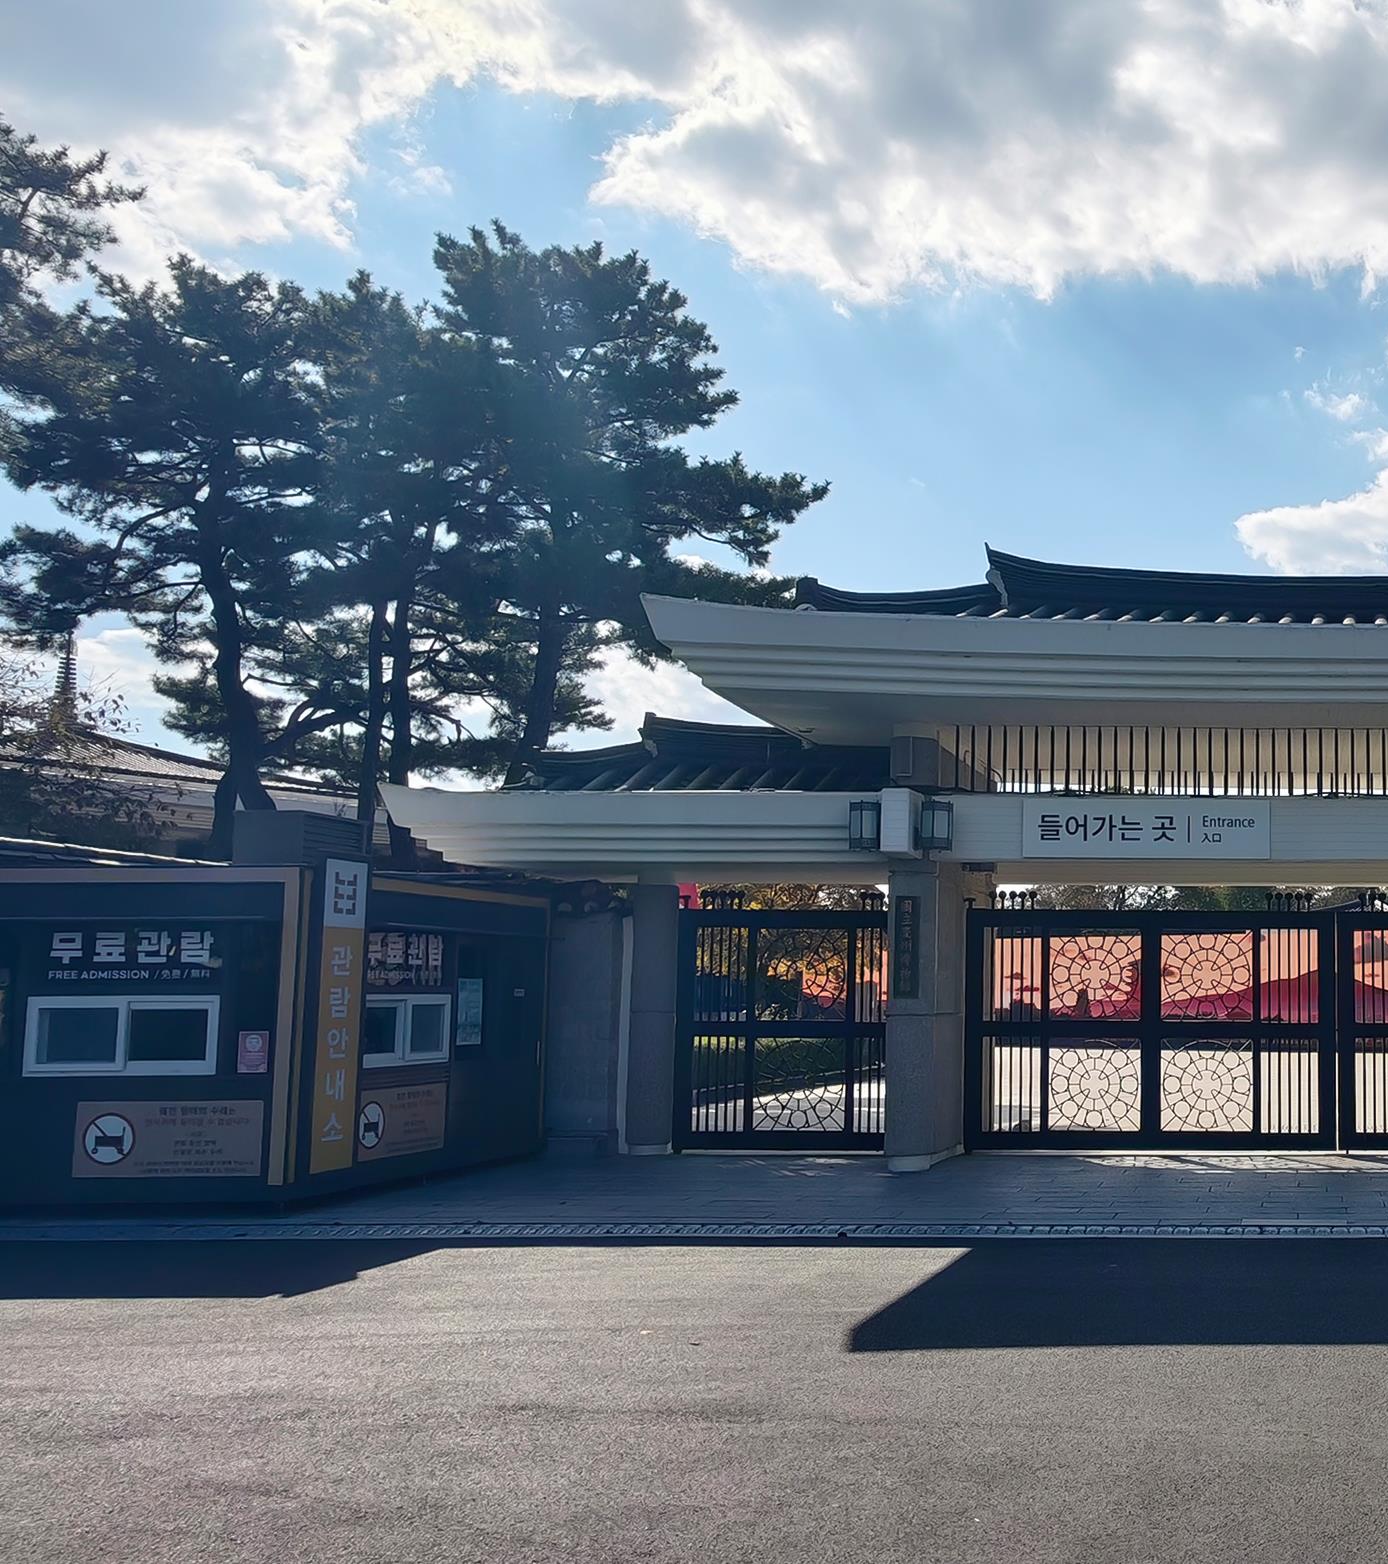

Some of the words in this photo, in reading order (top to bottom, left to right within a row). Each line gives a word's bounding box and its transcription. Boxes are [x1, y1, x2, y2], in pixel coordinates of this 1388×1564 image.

[1038, 814, 1144, 842] 들어가는
[1151, 815, 1177, 842] 곳
[1202, 815, 1255, 829] Entrance
[1201, 832, 1222, 844] 入口
[49, 930, 214, 965] 무료관람
[48, 970, 78, 980] FREE
[80, 970, 149, 980] ADMISSION
[320, 944, 353, 1143] 관람안내소
